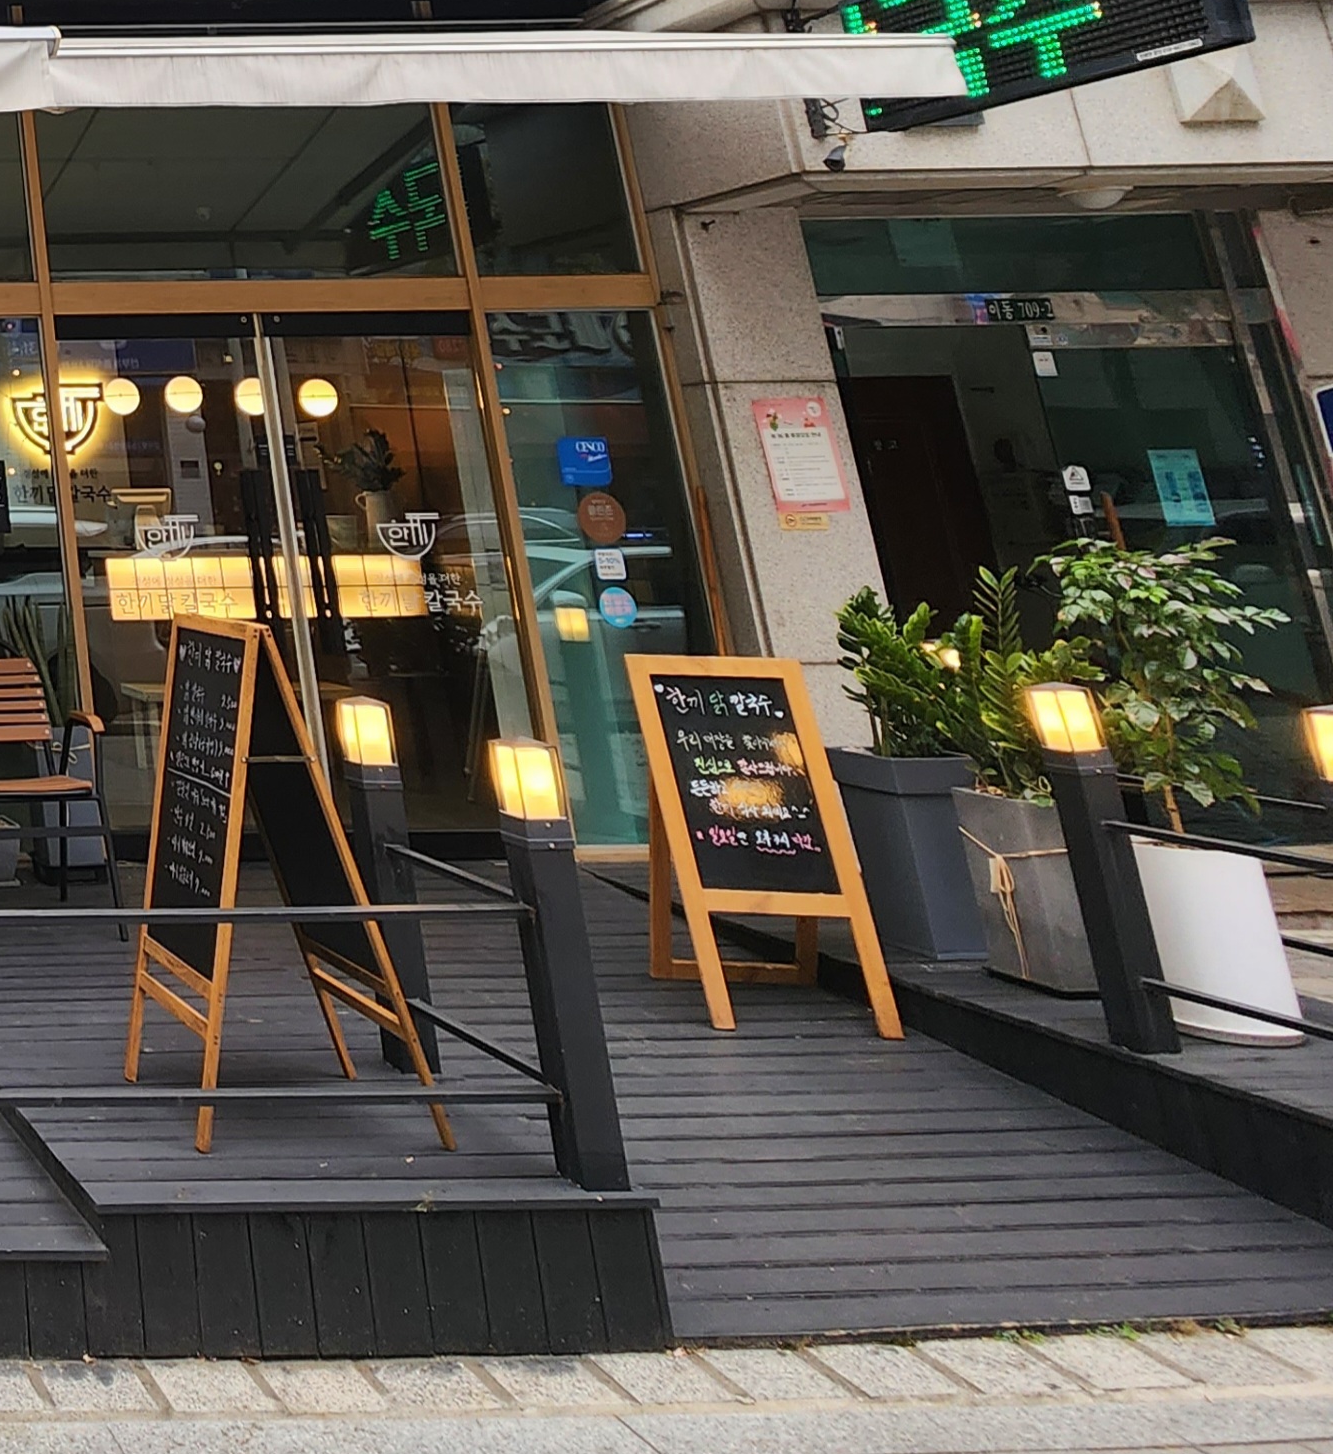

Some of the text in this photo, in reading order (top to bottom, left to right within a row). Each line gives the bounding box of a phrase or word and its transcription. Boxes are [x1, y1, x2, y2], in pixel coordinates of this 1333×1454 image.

[989, 300, 1014, 320] 이동
[424, 589, 484, 616] 칼국수
[666, 685, 773, 717] 한끼 닭 칼국수
[676, 728, 703, 752] 우리
